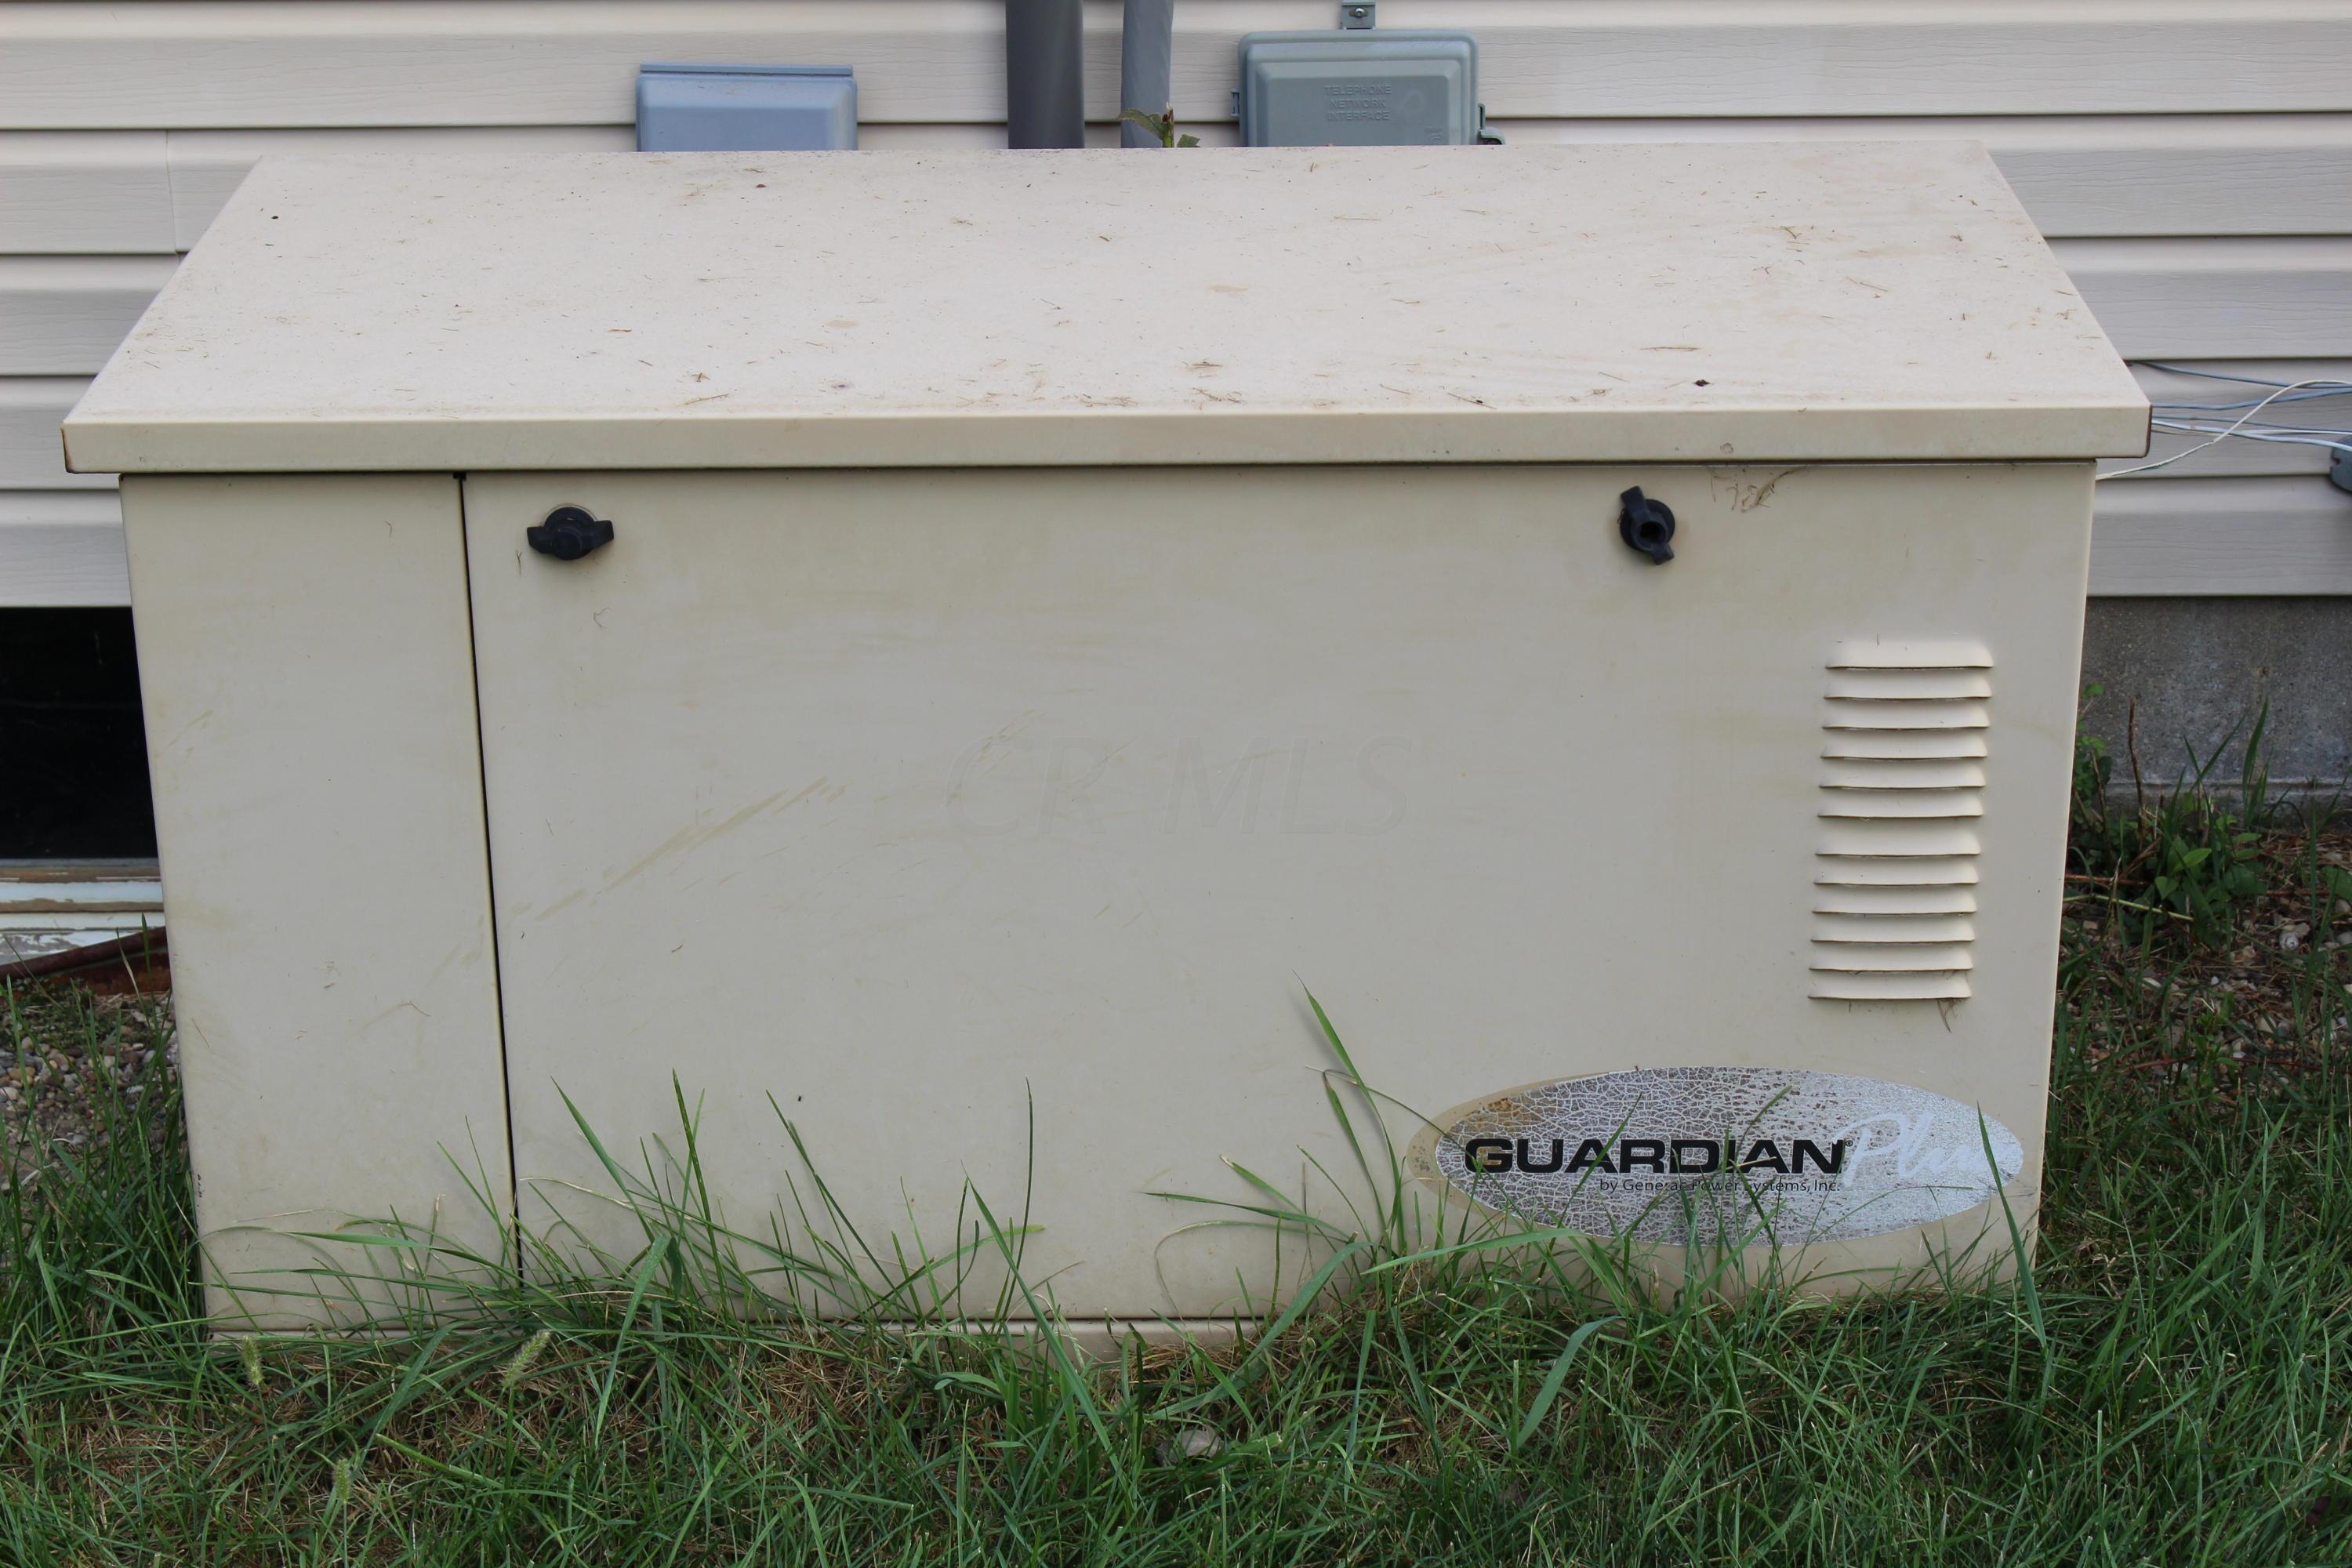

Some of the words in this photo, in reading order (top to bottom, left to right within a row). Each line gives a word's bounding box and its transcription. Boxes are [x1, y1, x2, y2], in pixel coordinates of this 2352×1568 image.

[1324, 84, 1393, 95] TELEPHONE
[1330, 98, 1387, 109] NETWORK
[1327, 111, 1390, 122] INTERFACE
[1600, 1178, 1618, 1193] by
[1814, 1179, 1840, 1191] Inc.
